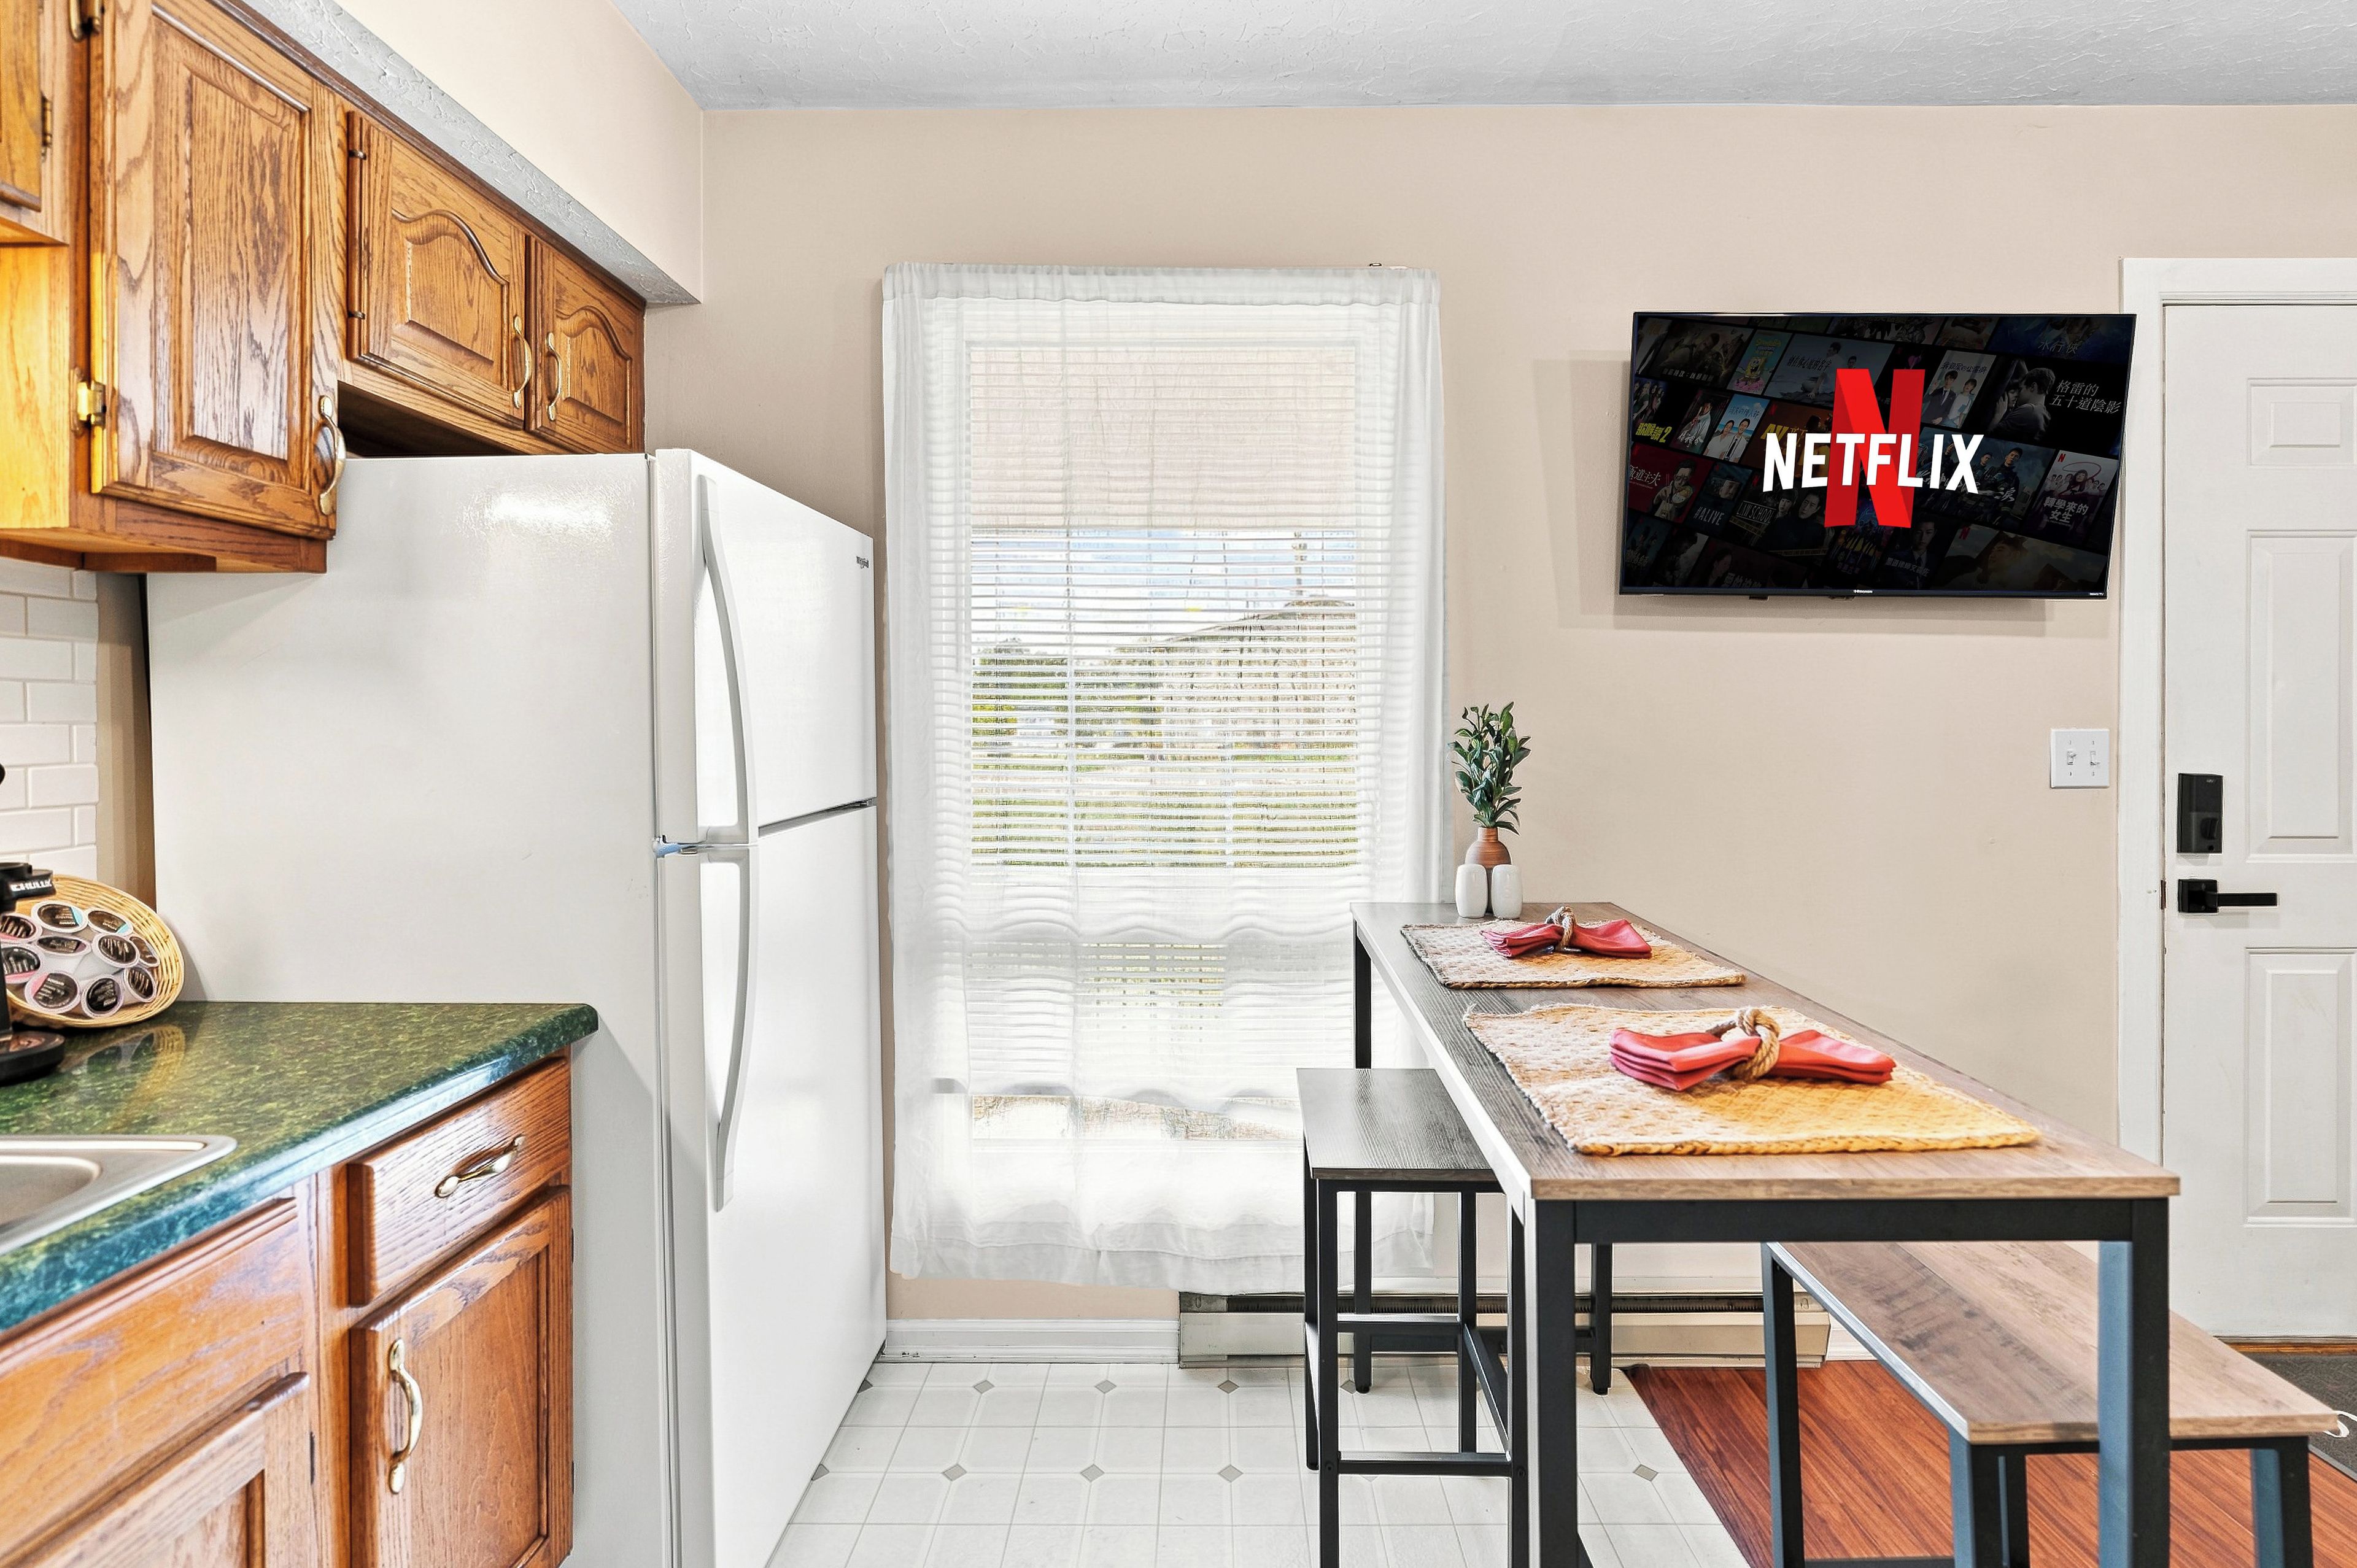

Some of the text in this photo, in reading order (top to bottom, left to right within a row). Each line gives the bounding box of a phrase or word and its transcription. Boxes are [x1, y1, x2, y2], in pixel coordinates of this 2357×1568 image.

[2056, 379, 2099, 397] 格雷的
[2049, 394, 2122, 415] 五十道陰影
[1763, 433, 1984, 494] NETFLIX
[1693, 505, 1725, 527] #ALIVE
[1749, 505, 1775, 524] SCHOOL
[2043, 496, 2089, 516] 轉學來的
[2049, 509, 2072, 523] 女生
